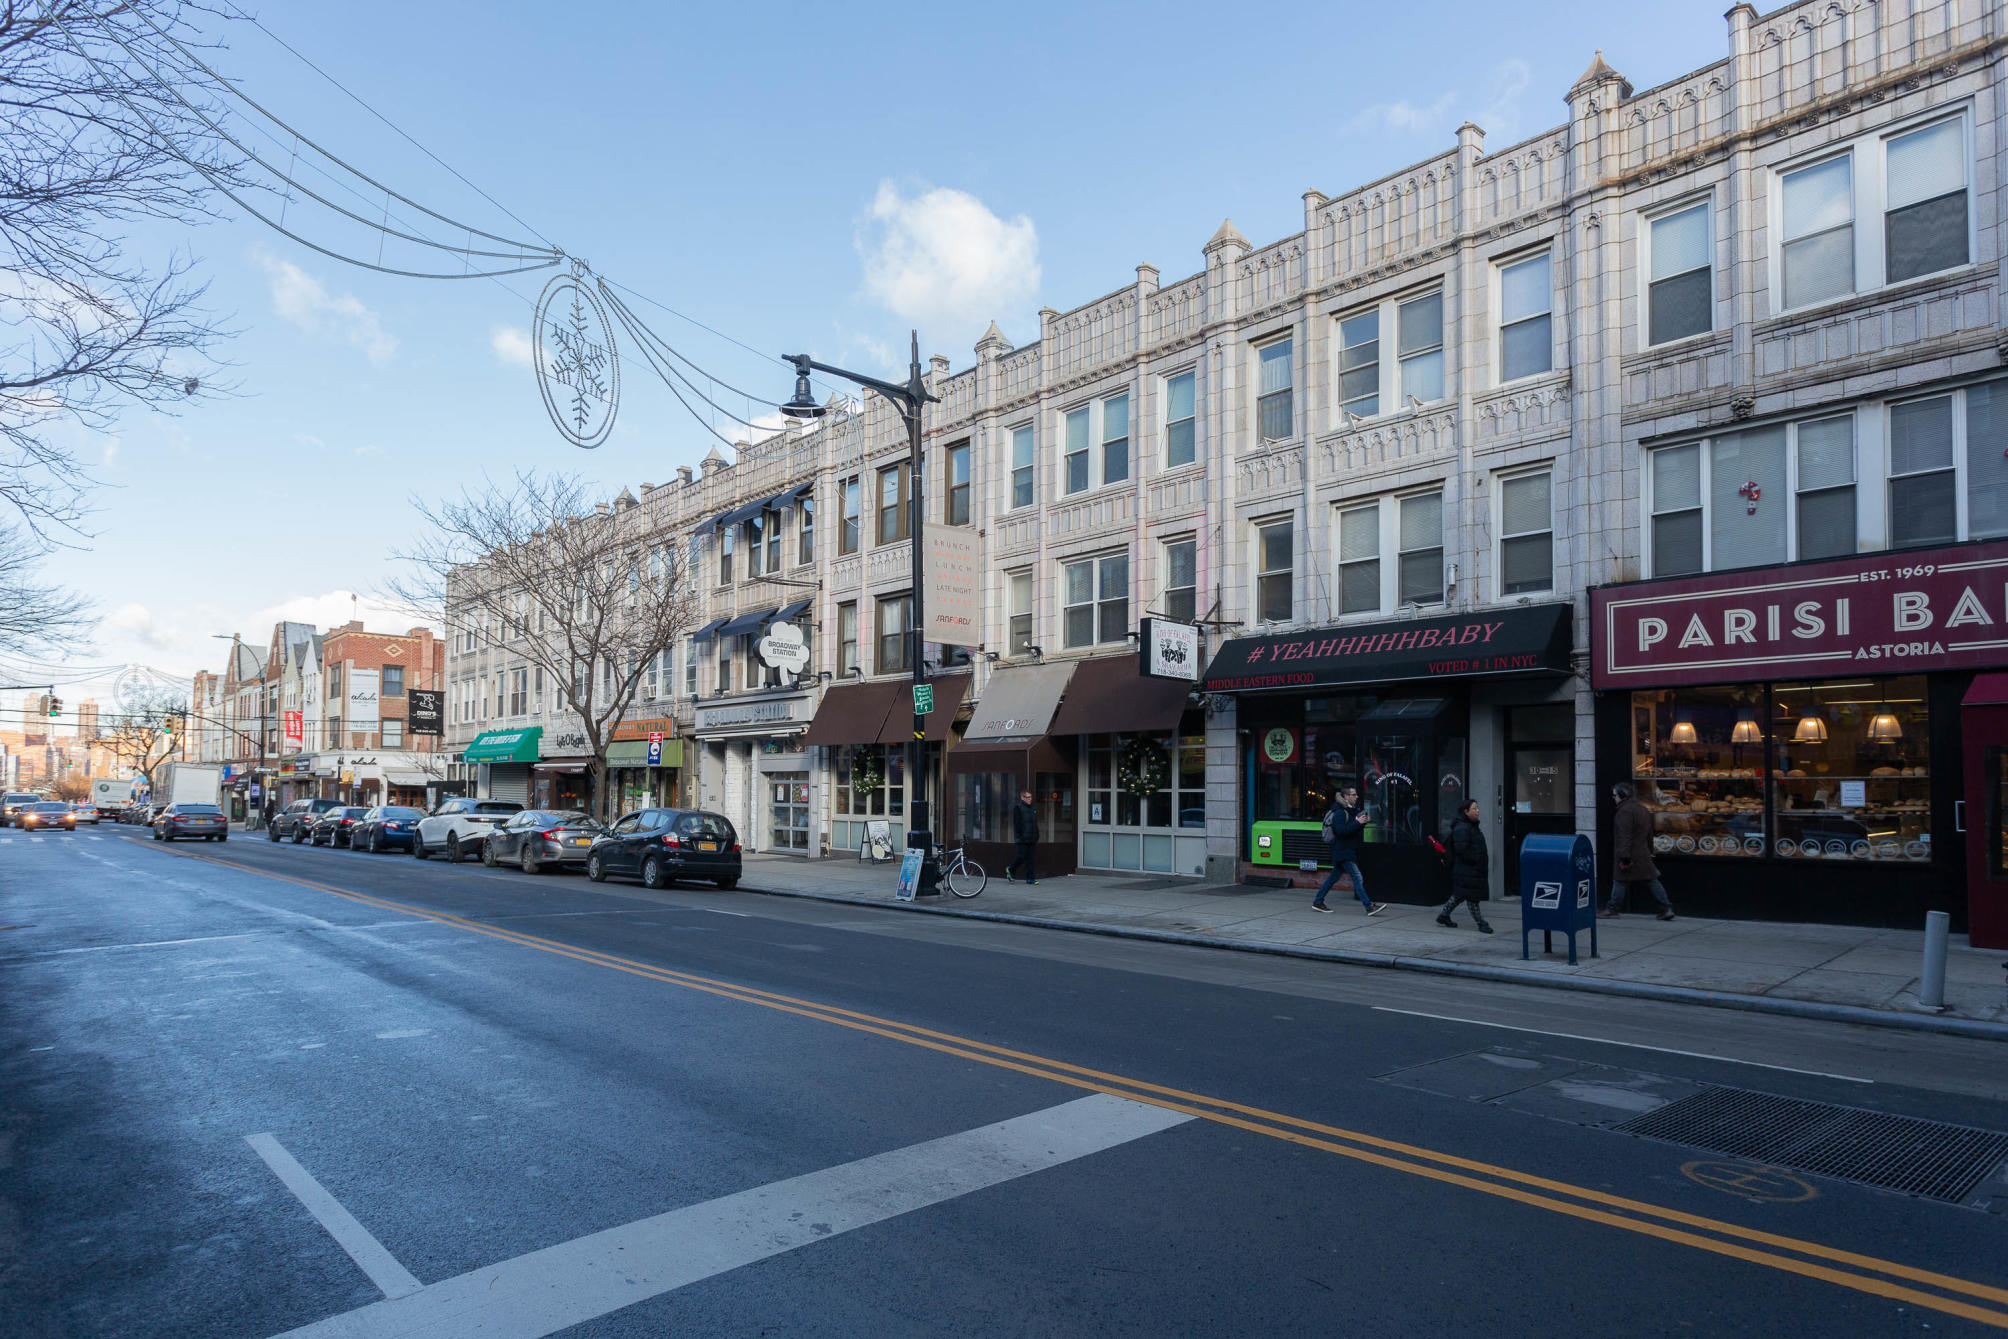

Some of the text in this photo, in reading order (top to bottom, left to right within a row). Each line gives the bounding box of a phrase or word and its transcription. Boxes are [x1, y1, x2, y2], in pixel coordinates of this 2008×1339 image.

[933, 538, 971, 551] BRUNCH
[935, 561, 972, 574] LUNCH
[1859, 564, 1935, 583] EST. 1969
[936, 583, 973, 597] LATE NIGHT
[1638, 582, 2008, 653] PARISI BA
[767, 639, 801, 651] BROADWAY
[1854, 640, 1945, 660] ASTORIA
[772, 647, 797, 657] STATION
[1427, 659, 1469, 673] VOTED
[1494, 657, 1508, 669] IN
[1511, 654, 1537, 667] NYC
[1206, 672, 1315, 690] MIDDLE EASTERN FOOD
[636, 721, 668, 732] NATURAL
[1094, 807, 1100, 816] A
